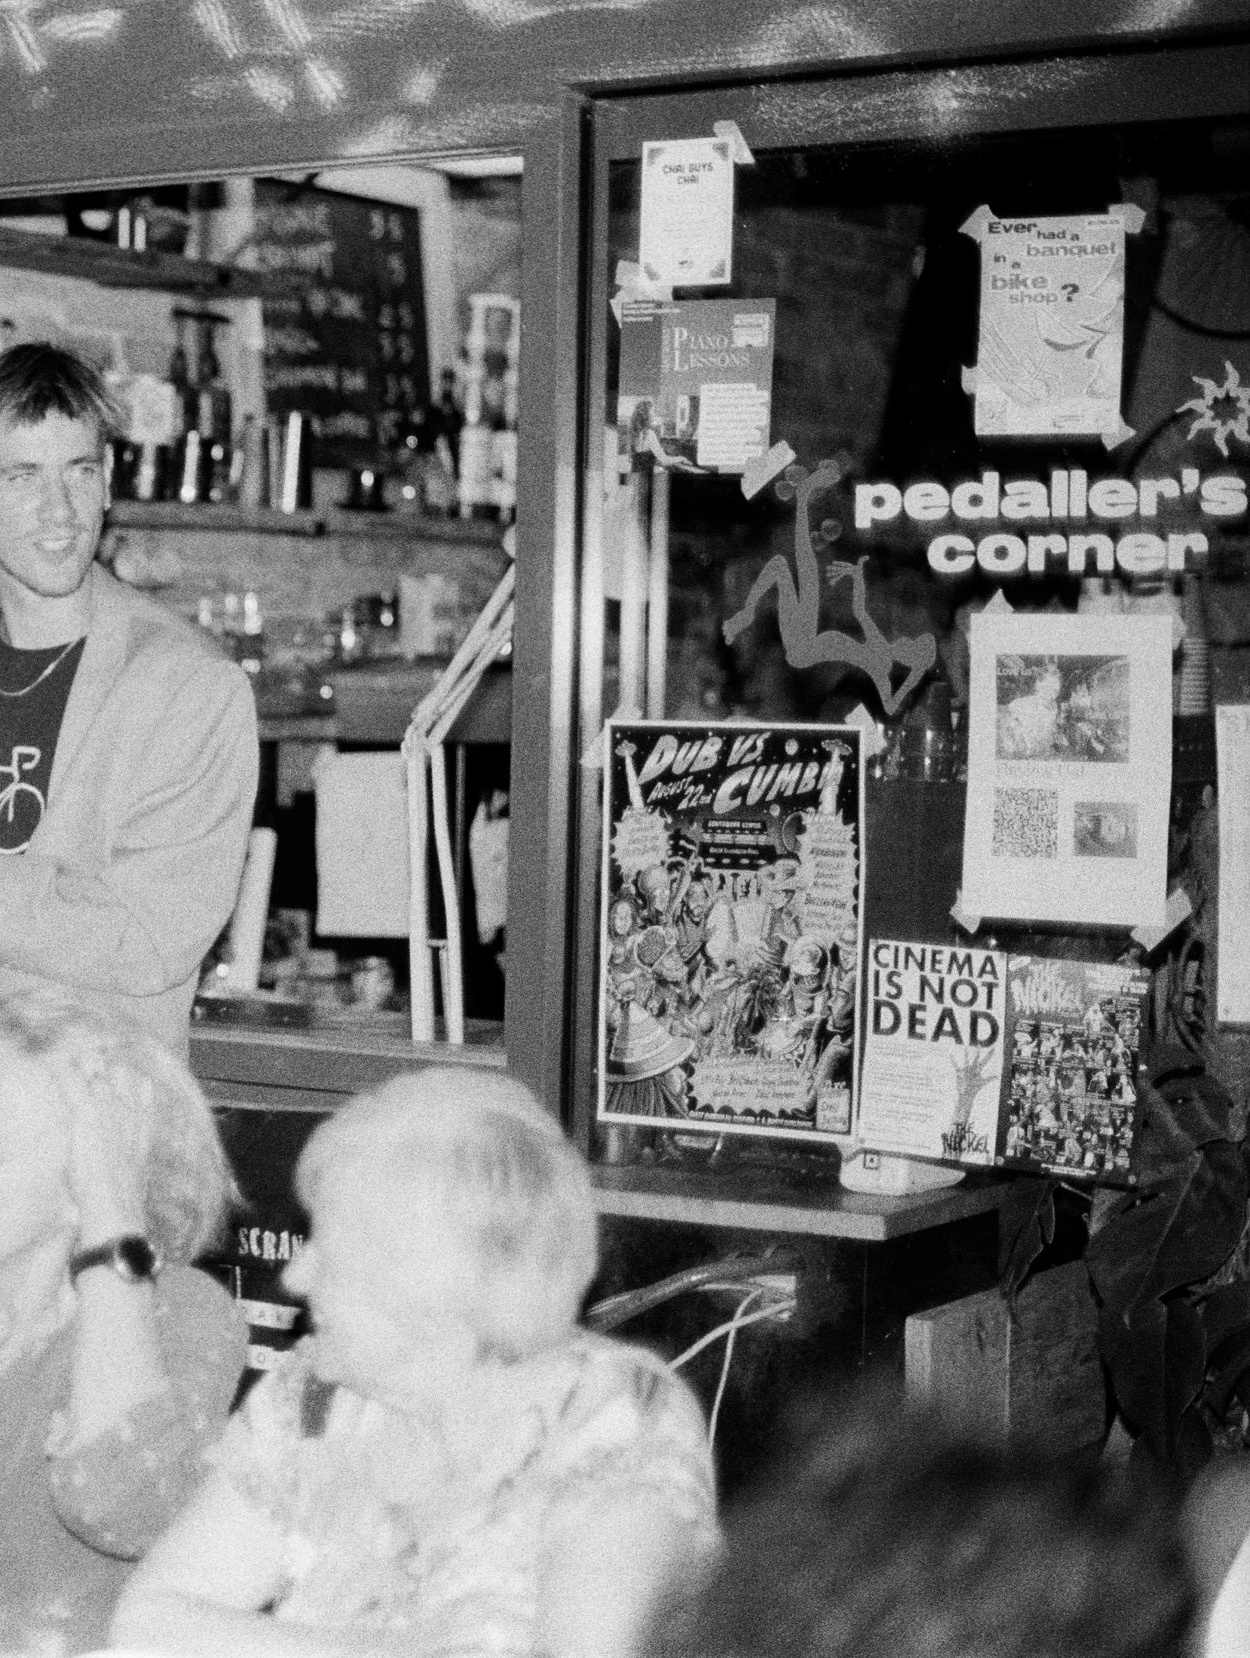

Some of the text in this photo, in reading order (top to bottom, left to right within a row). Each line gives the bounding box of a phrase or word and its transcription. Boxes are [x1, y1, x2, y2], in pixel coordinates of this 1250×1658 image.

[987, 220, 1081, 242] Ever had a
[1026, 241, 1117, 259] banquet
[993, 252, 1007, 264] in
[991, 273, 1050, 292] bike
[855, 468, 1248, 528] pedaller's
[927, 533, 1209, 573] corner
[637, 734, 723, 785] DUB
[873, 943, 999, 981] CINEMA
[873, 969, 999, 1010] IS NOT
[872, 999, 1000, 1048] DEAD
